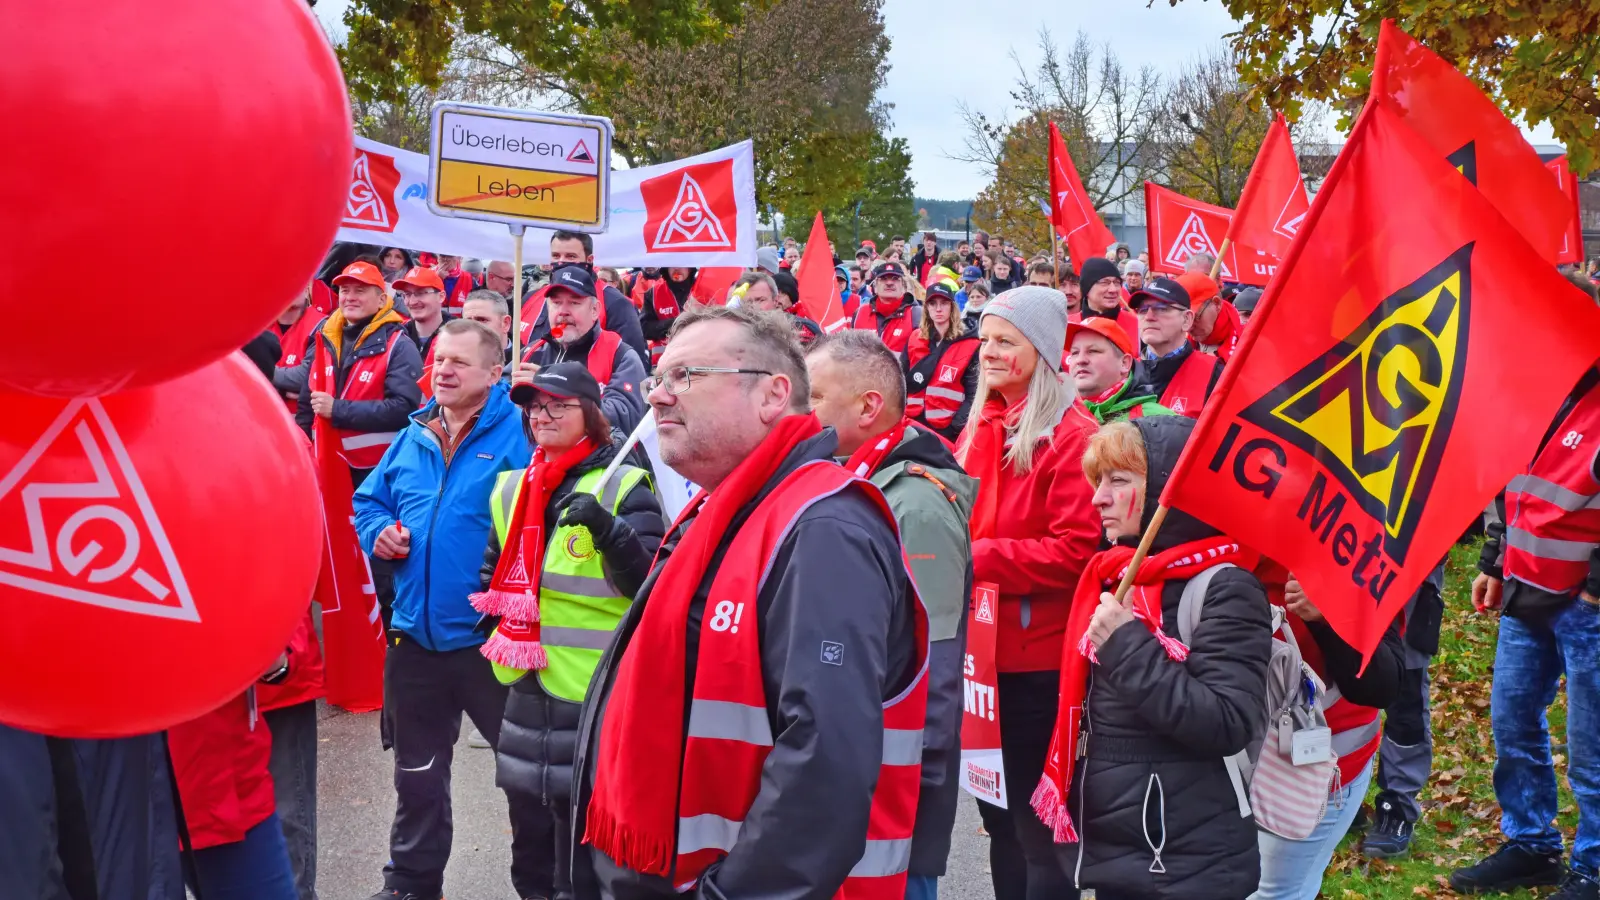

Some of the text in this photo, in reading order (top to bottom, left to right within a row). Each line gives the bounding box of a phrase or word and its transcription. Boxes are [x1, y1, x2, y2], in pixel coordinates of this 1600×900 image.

[452, 124, 563, 157] Überleben
[477, 175, 555, 203] Leben
[359, 370, 374, 383] 8!
[1561, 430, 1584, 450] 8!
[1208, 421, 1287, 500] IG
[709, 599, 745, 635] 8!
